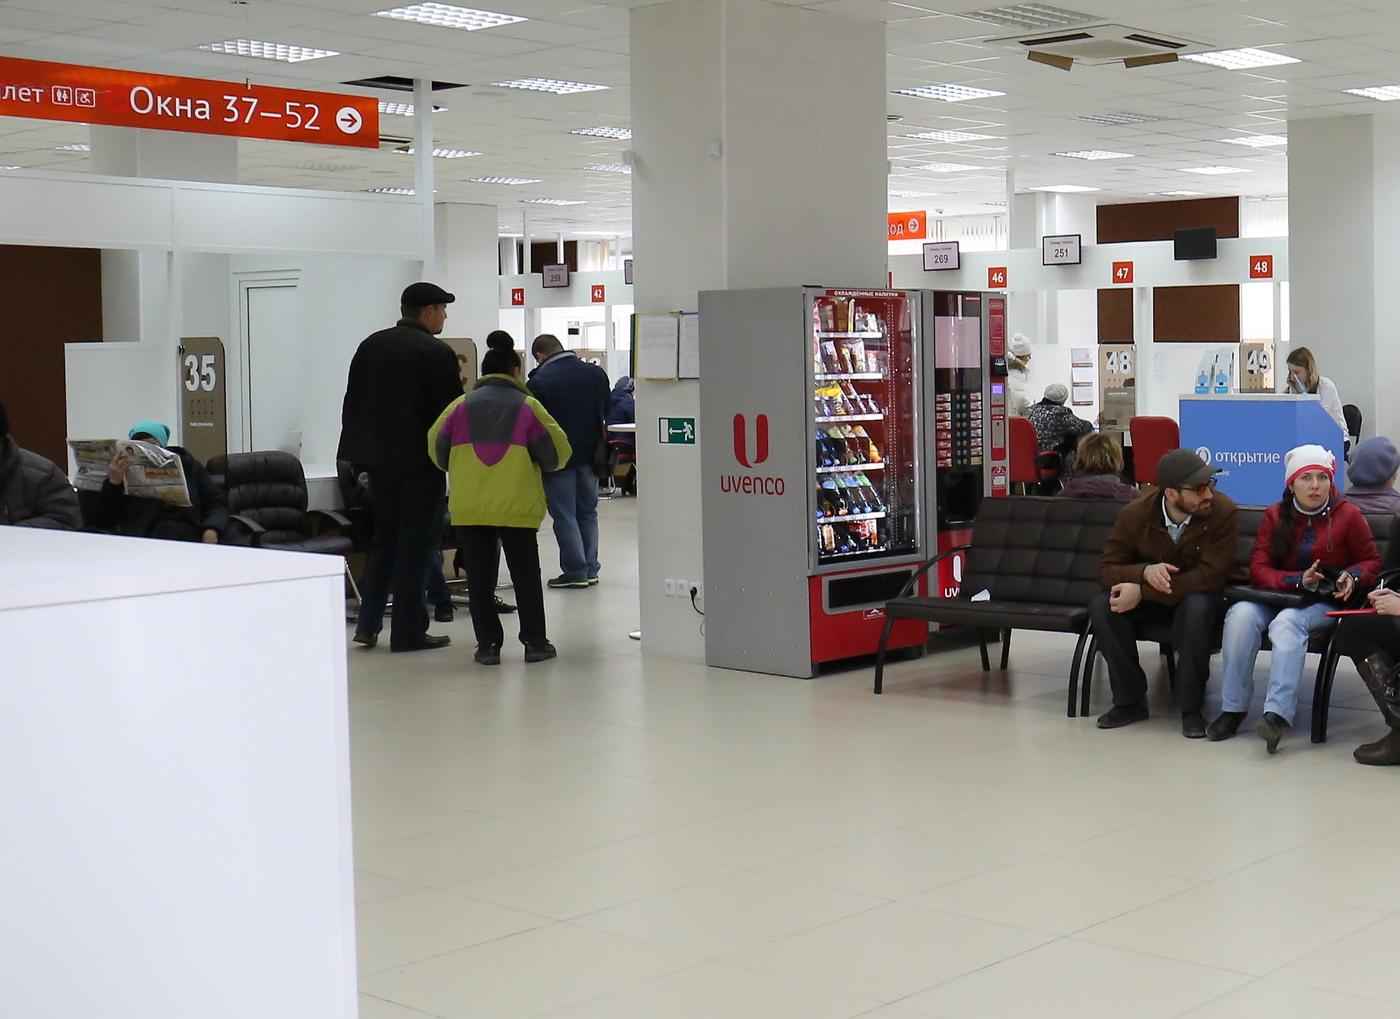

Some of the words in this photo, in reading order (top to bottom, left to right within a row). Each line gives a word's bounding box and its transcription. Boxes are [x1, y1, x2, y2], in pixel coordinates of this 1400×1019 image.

[0, 85, 44, 103] лет
[129, 86, 211, 120] Окна
[934, 254, 949, 264] 269
[1054, 248, 1069, 258] 251
[1116, 267, 1129, 279] 47
[1254, 261, 1268, 273] 48
[992, 272, 1004, 283] 46
[514, 292, 522, 301] 41
[593, 289, 602, 299] 42
[1106, 351, 1134, 374] 48
[1247, 351, 1271, 375] 49
[184, 354, 216, 392] 35
[1215, 451, 1281, 467] открытие
[720, 475, 785, 496] uvenco
